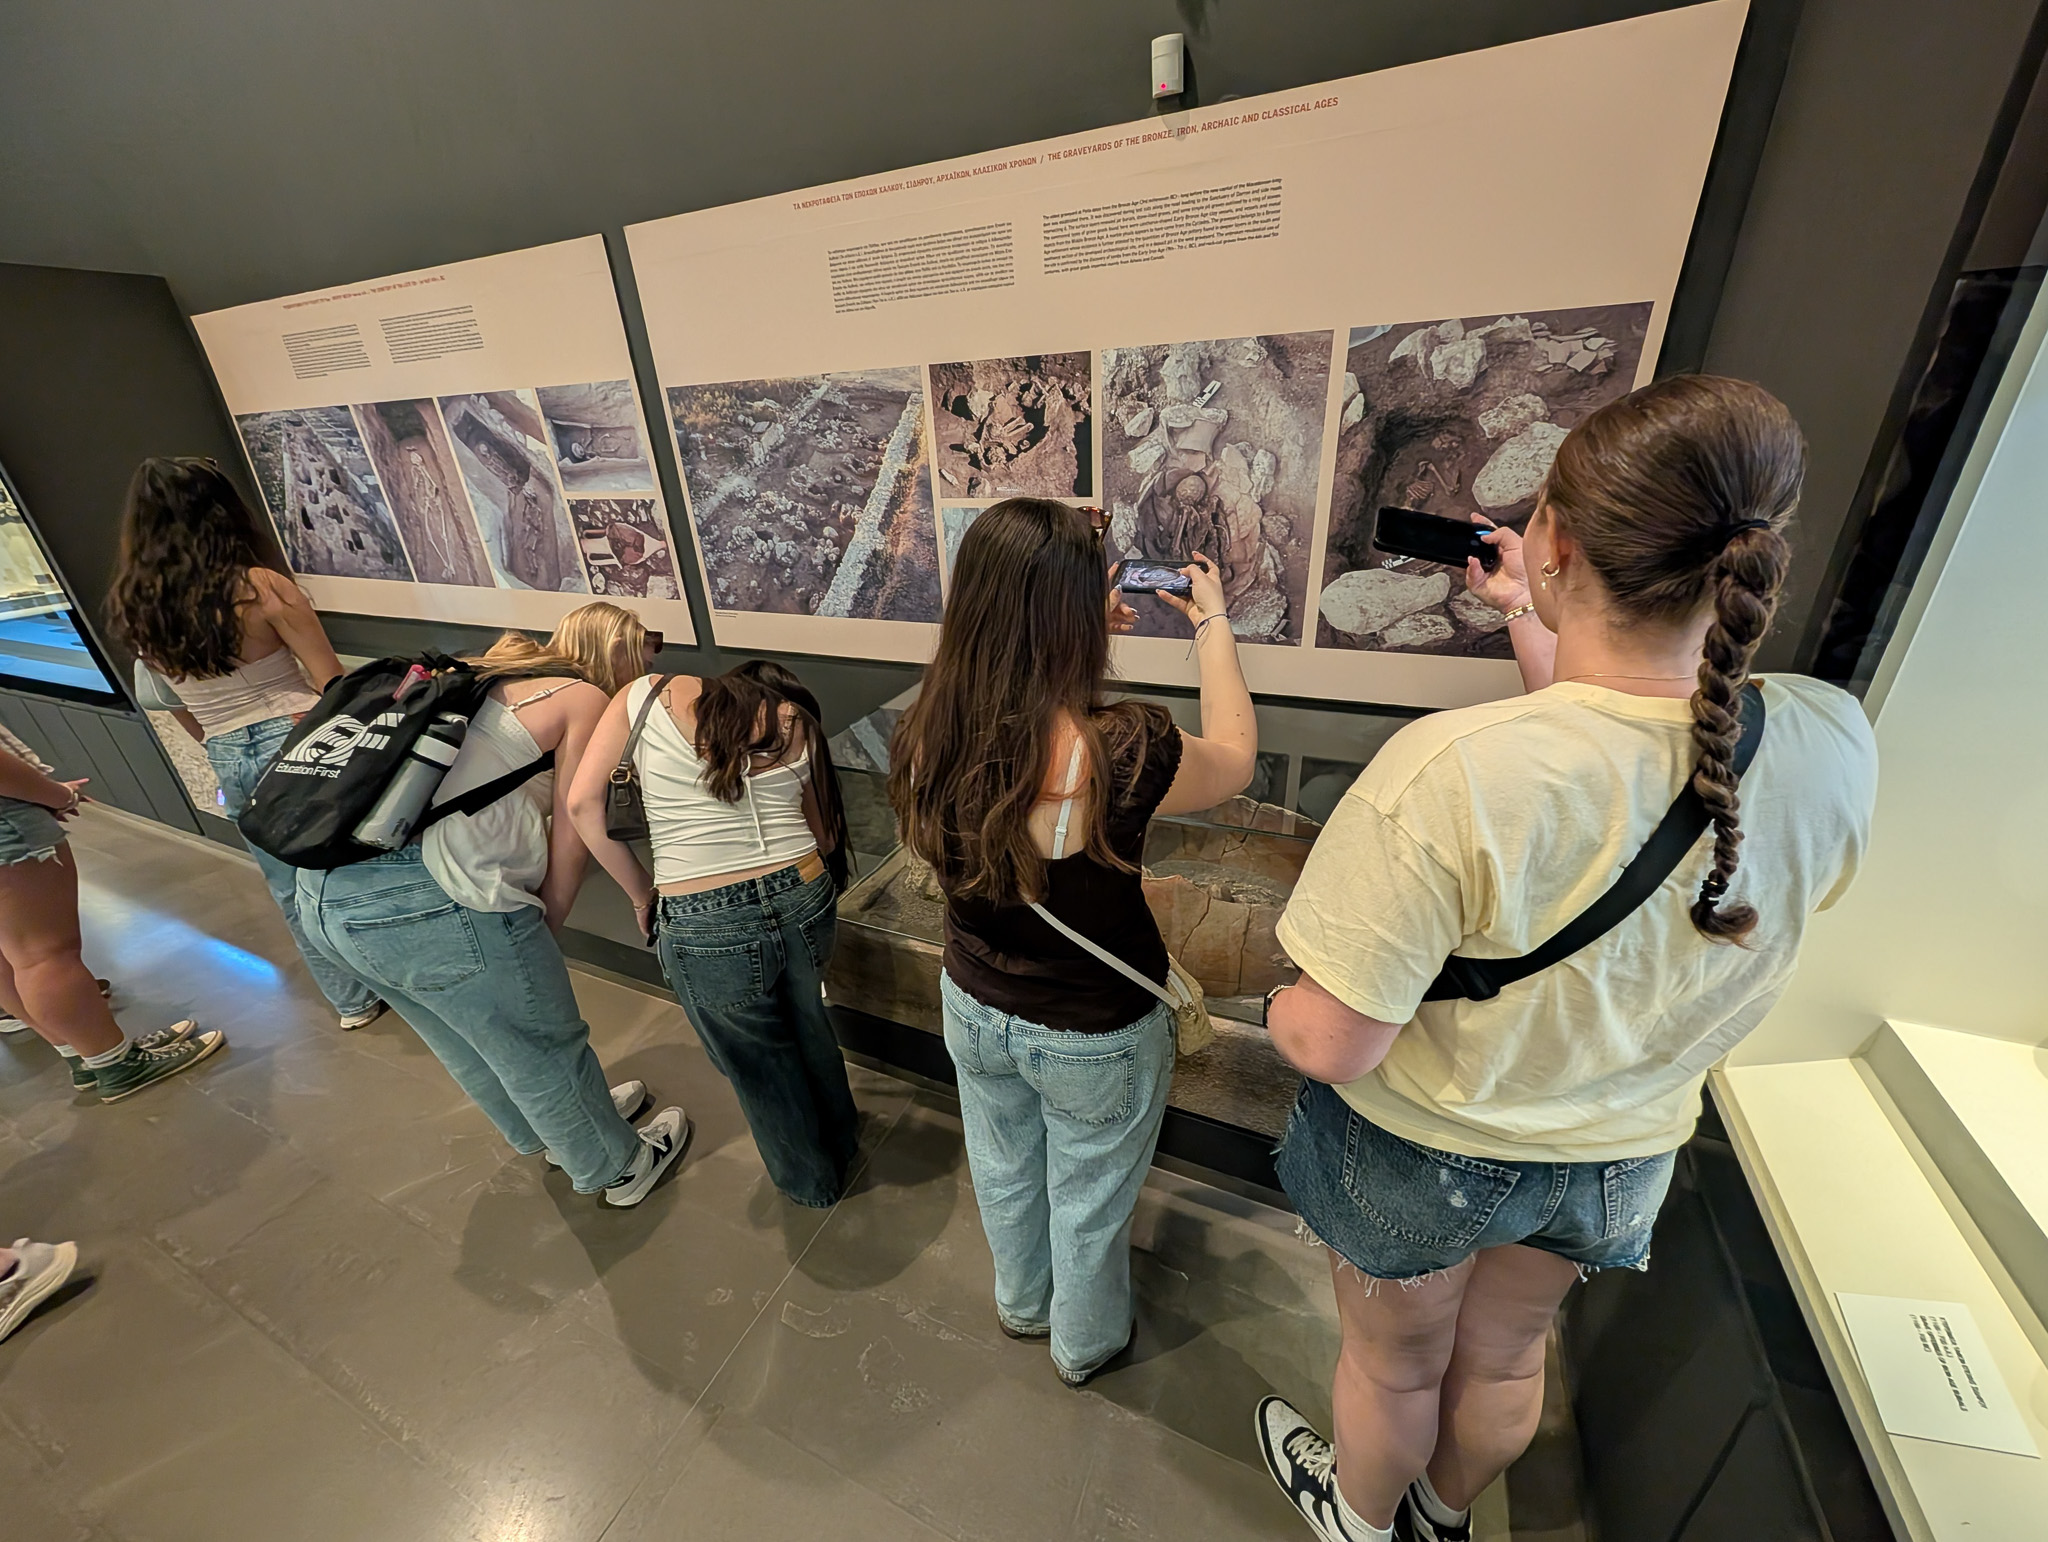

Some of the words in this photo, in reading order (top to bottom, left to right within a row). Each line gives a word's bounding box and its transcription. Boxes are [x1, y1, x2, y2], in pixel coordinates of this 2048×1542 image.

[972, 162, 1007, 176] ΚΛΑΣΙΚΩΝ
[1009, 156, 1037, 169] ΧΡΟΝΩΝ
[1047, 151, 1062, 161] THE
[1063, 141, 1112, 159] GRAVEYARDS
[1113, 139, 1124, 149] OF
[1125, 135, 1140, 146] THE
[1142, 129, 1175, 143] BRONZE,
[1176, 124, 1199, 137] IRON,
[1201, 116, 1240, 132] ARCHAIC
[1241, 112, 1260, 124] AND
[1261, 102, 1312, 120] CLASSICAL
[1313, 97, 1339, 110] AGES
[275, 762, 314, 776] Education
[313, 766, 341, 778] First
